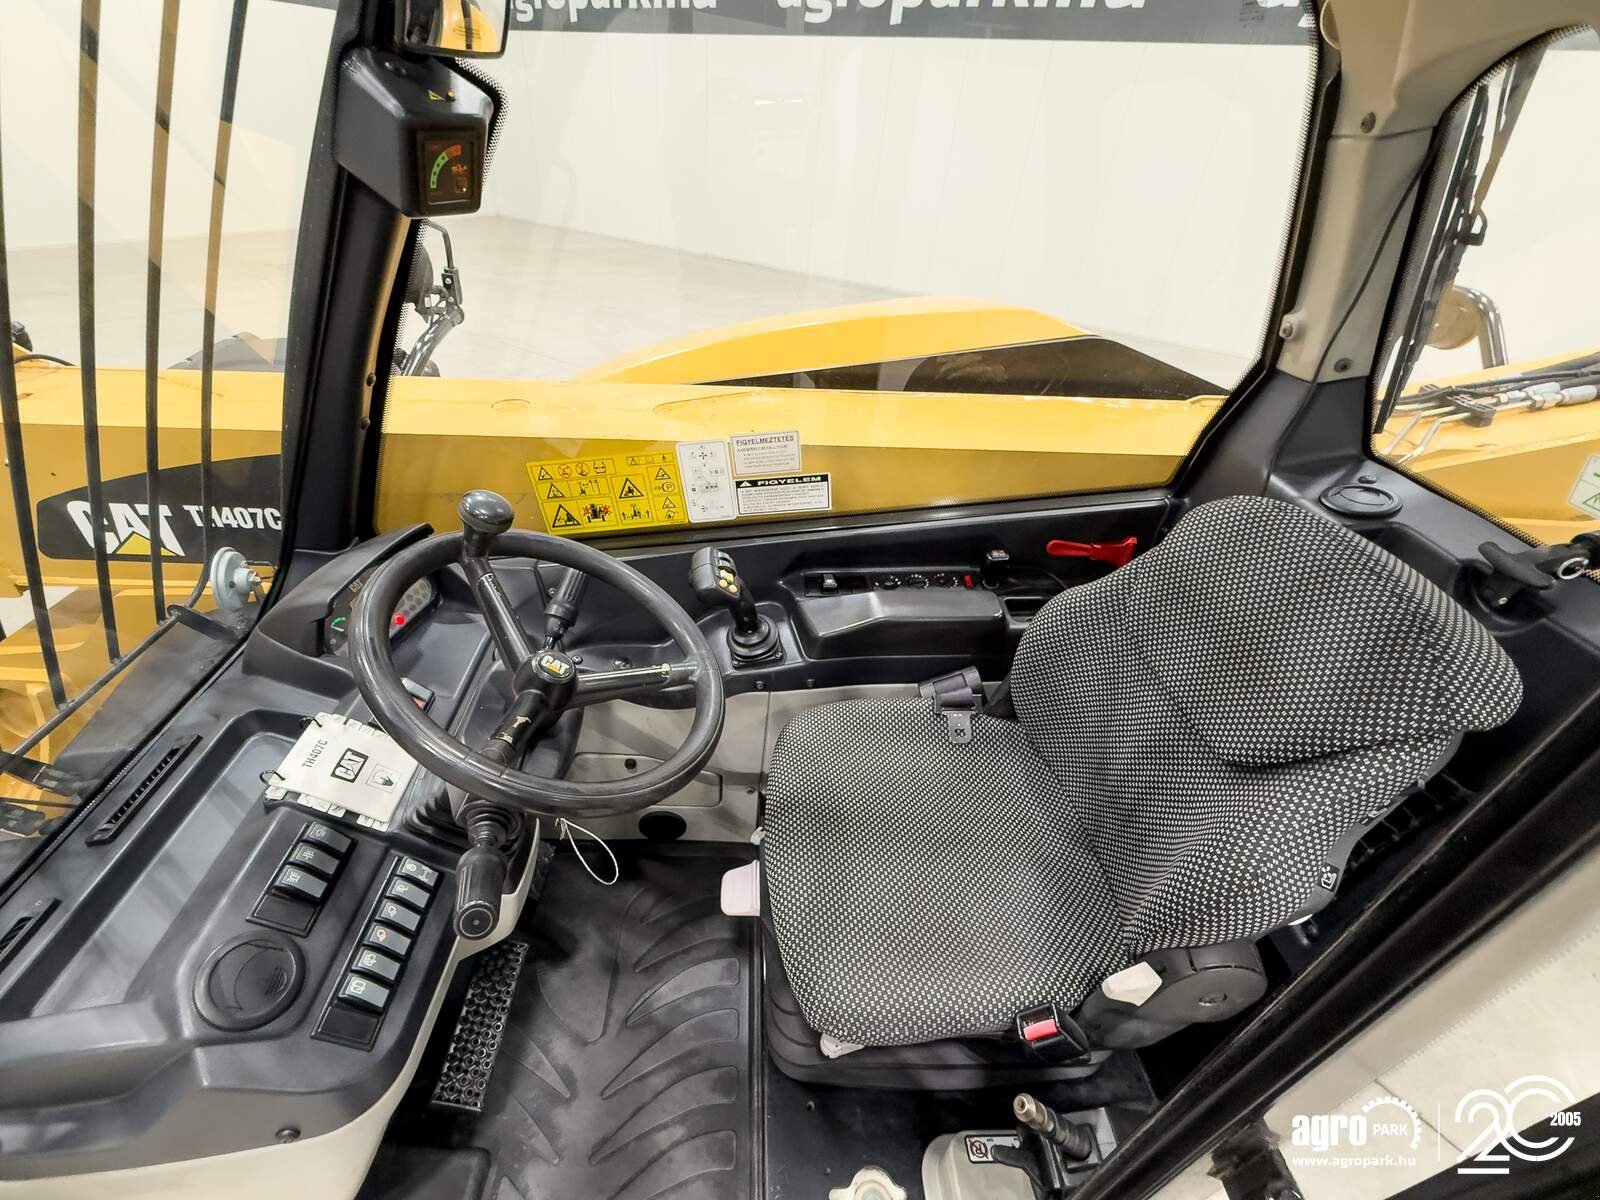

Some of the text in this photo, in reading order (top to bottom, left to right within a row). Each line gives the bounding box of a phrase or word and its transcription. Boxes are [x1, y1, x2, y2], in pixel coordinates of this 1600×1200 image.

[757, 476, 821, 486] FIGYELEM
[66, 500, 186, 557] CAT
[541, 655, 569, 675] CAT
[301, 739, 328, 768] TH407C
[332, 750, 365, 782] CAT
